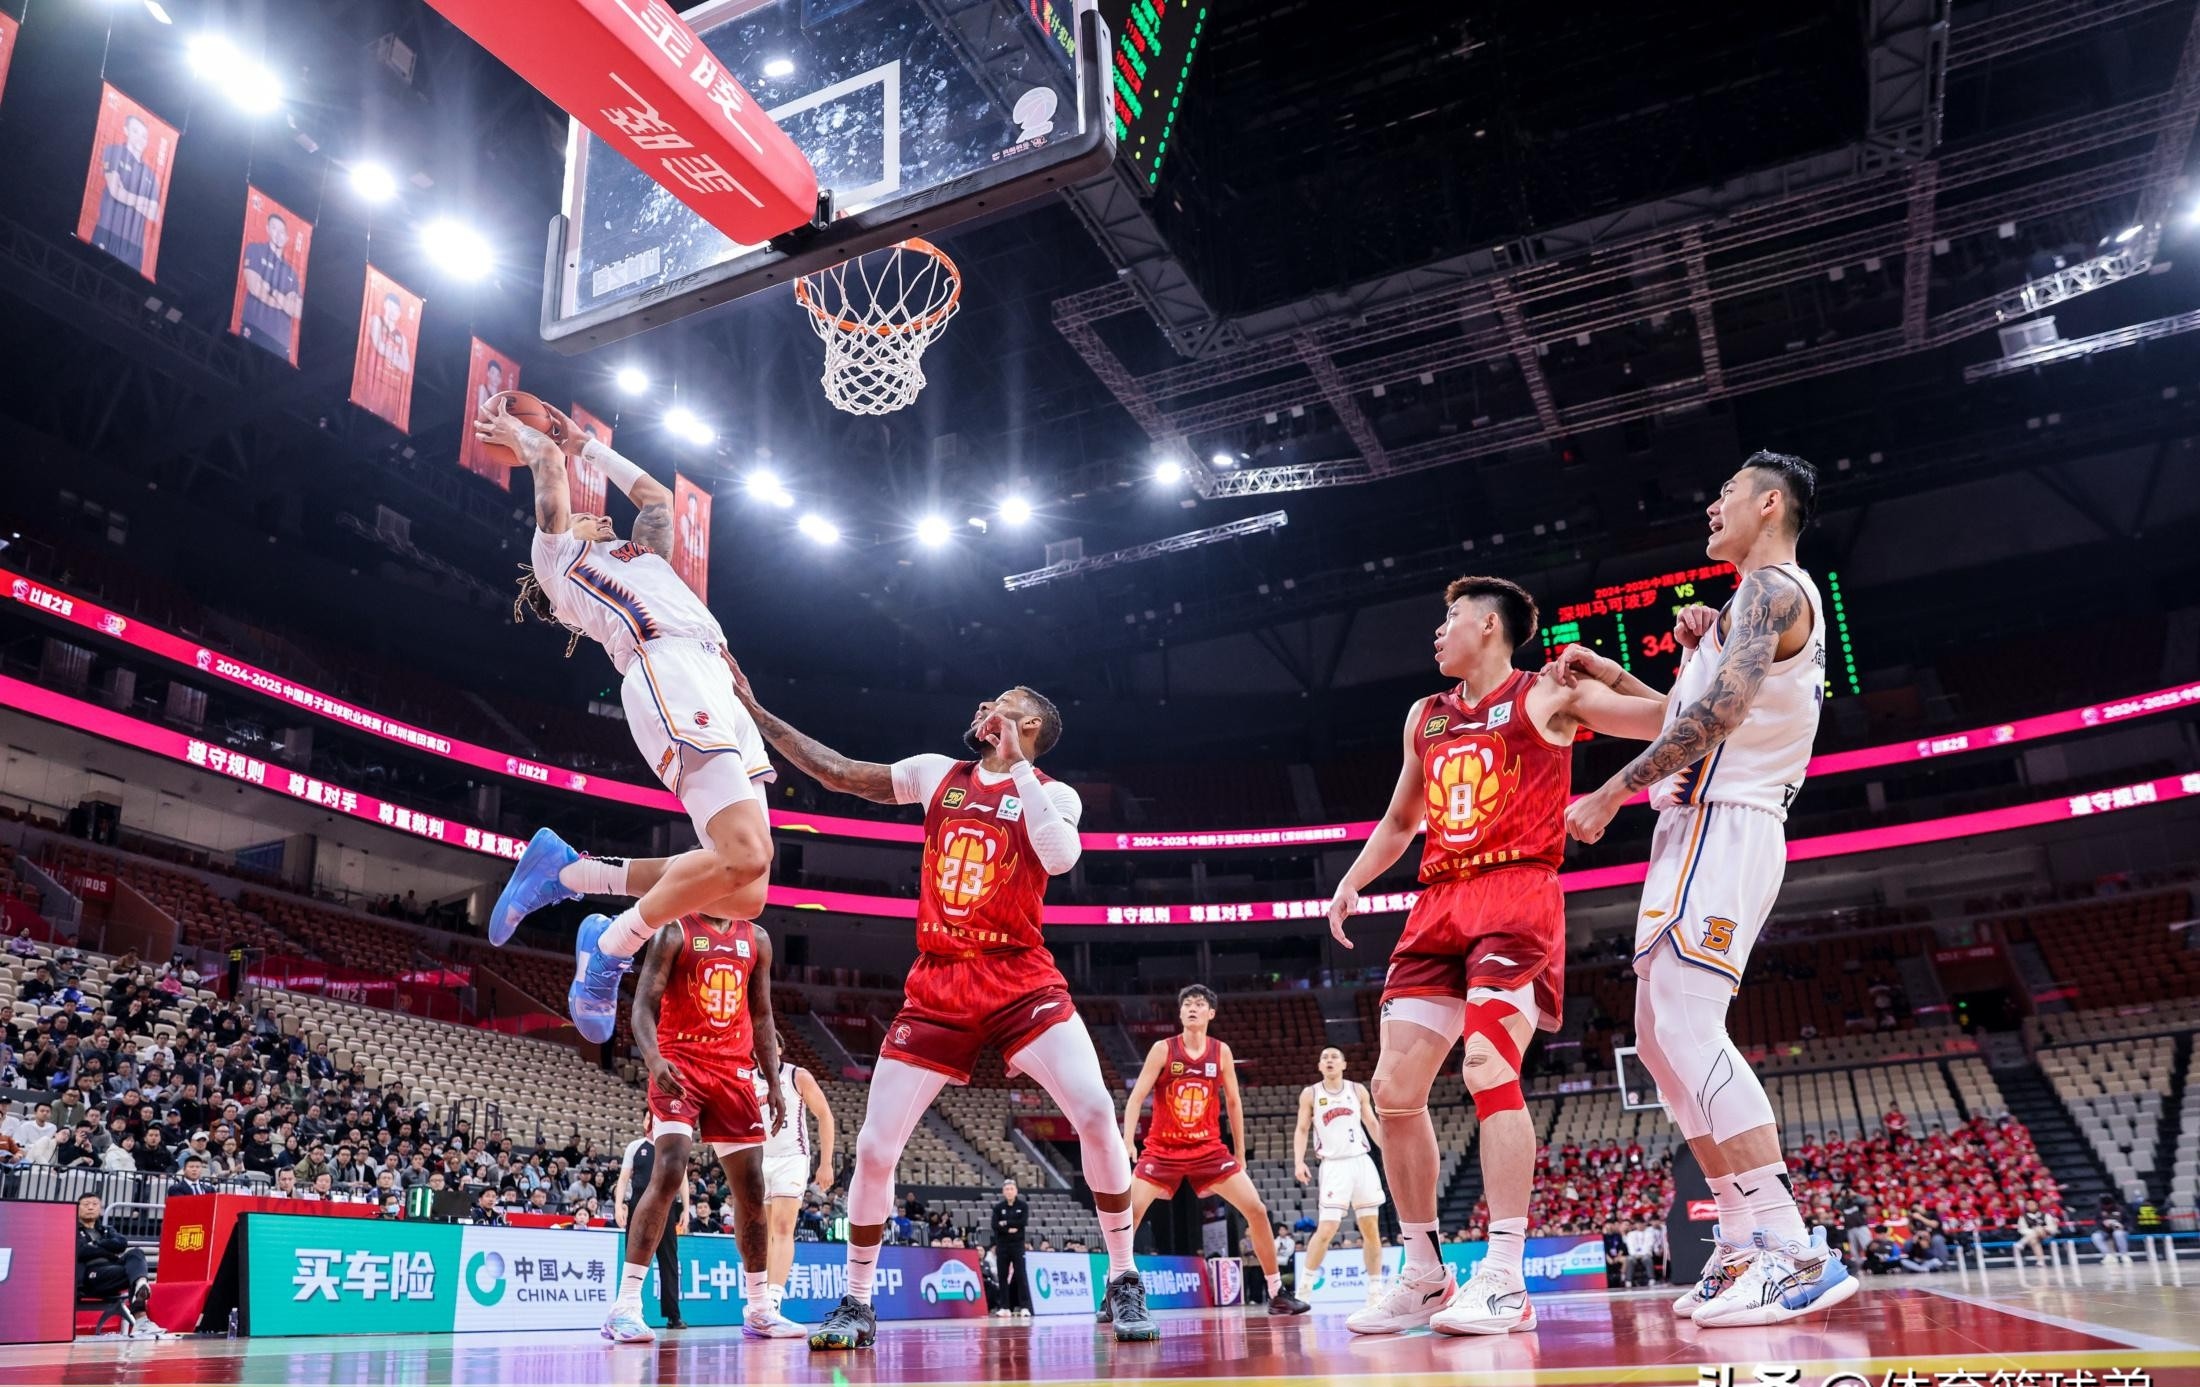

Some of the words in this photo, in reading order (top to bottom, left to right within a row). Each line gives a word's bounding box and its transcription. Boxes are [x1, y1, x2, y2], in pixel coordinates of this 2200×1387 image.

[29, 587, 73, 616] 以城之名
[1674, 583, 1695, 599] VS
[1557, 588, 1658, 623] 深圳马可波罗
[1641, 631, 1677, 657] 34
[216, 658, 282, 694] 2024-2025
[283, 685, 385, 731] 中国男子篮球职业联赛
[186, 736, 266, 784] 遵守规则
[287, 772, 357, 813] 尊重对手
[378, 801, 445, 840] 尊重裁判
[1449, 782, 1474, 823] 8
[1132, 836, 1189, 847] 2024-2025
[940, 856, 986, 896] 23
[1107, 906, 1171, 924] 遵守规则
[1189, 904, 1253, 922] 尊重对手
[1179, 1098, 1205, 1120] 33
[292, 1248, 435, 1301] 买车险
[514, 1256, 606, 1284] 中国人寿
[1052, 1271, 1086, 1285] 中国人寿
[517, 1288, 569, 1302] CHINA
[574, 1288, 607, 1303] LIFE
